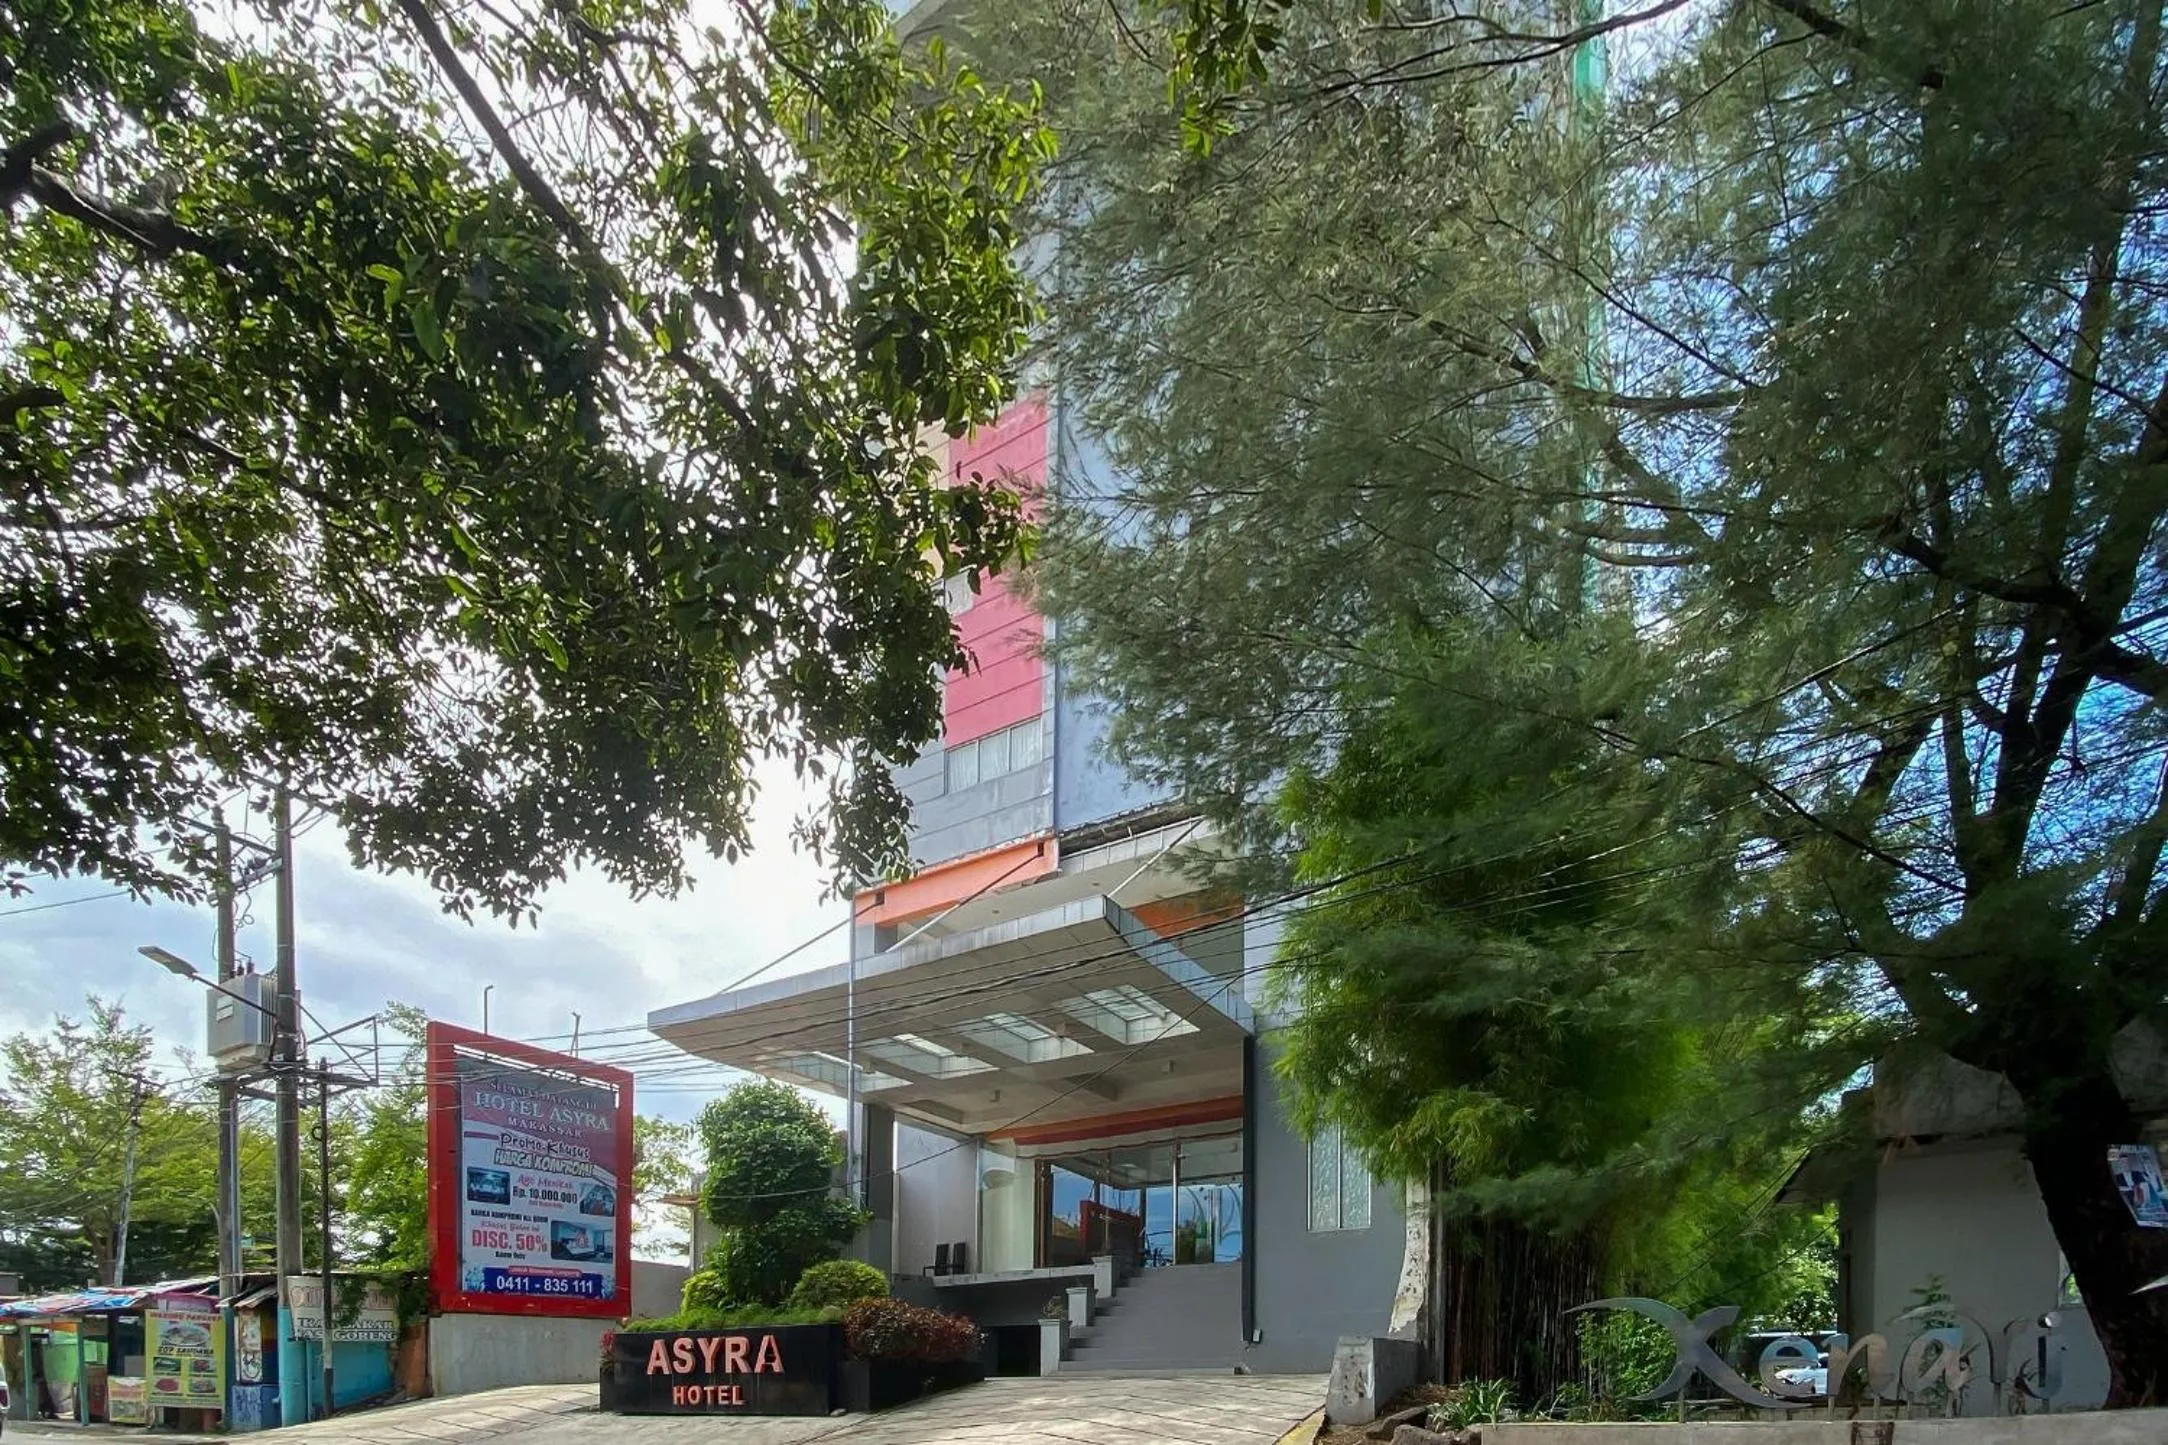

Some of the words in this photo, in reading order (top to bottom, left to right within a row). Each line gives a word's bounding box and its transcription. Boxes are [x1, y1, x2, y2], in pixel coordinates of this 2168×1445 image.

[475, 1091, 544, 1118] HOTEL
[550, 1107, 610, 1131] ASYRA
[508, 1116, 583, 1138] MAKASSAR
[472, 1229, 512, 1250] DISC.
[516, 1233, 548, 1252] 50%
[496, 1275, 529, 1290] 0411
[543, 1278, 569, 1292] 835
[573, 1279, 593, 1293] 111
[334, 1330, 397, 1341] GORENG
[646, 1334, 785, 1375] ASYRA
[672, 1385, 747, 1406] HOTEL
